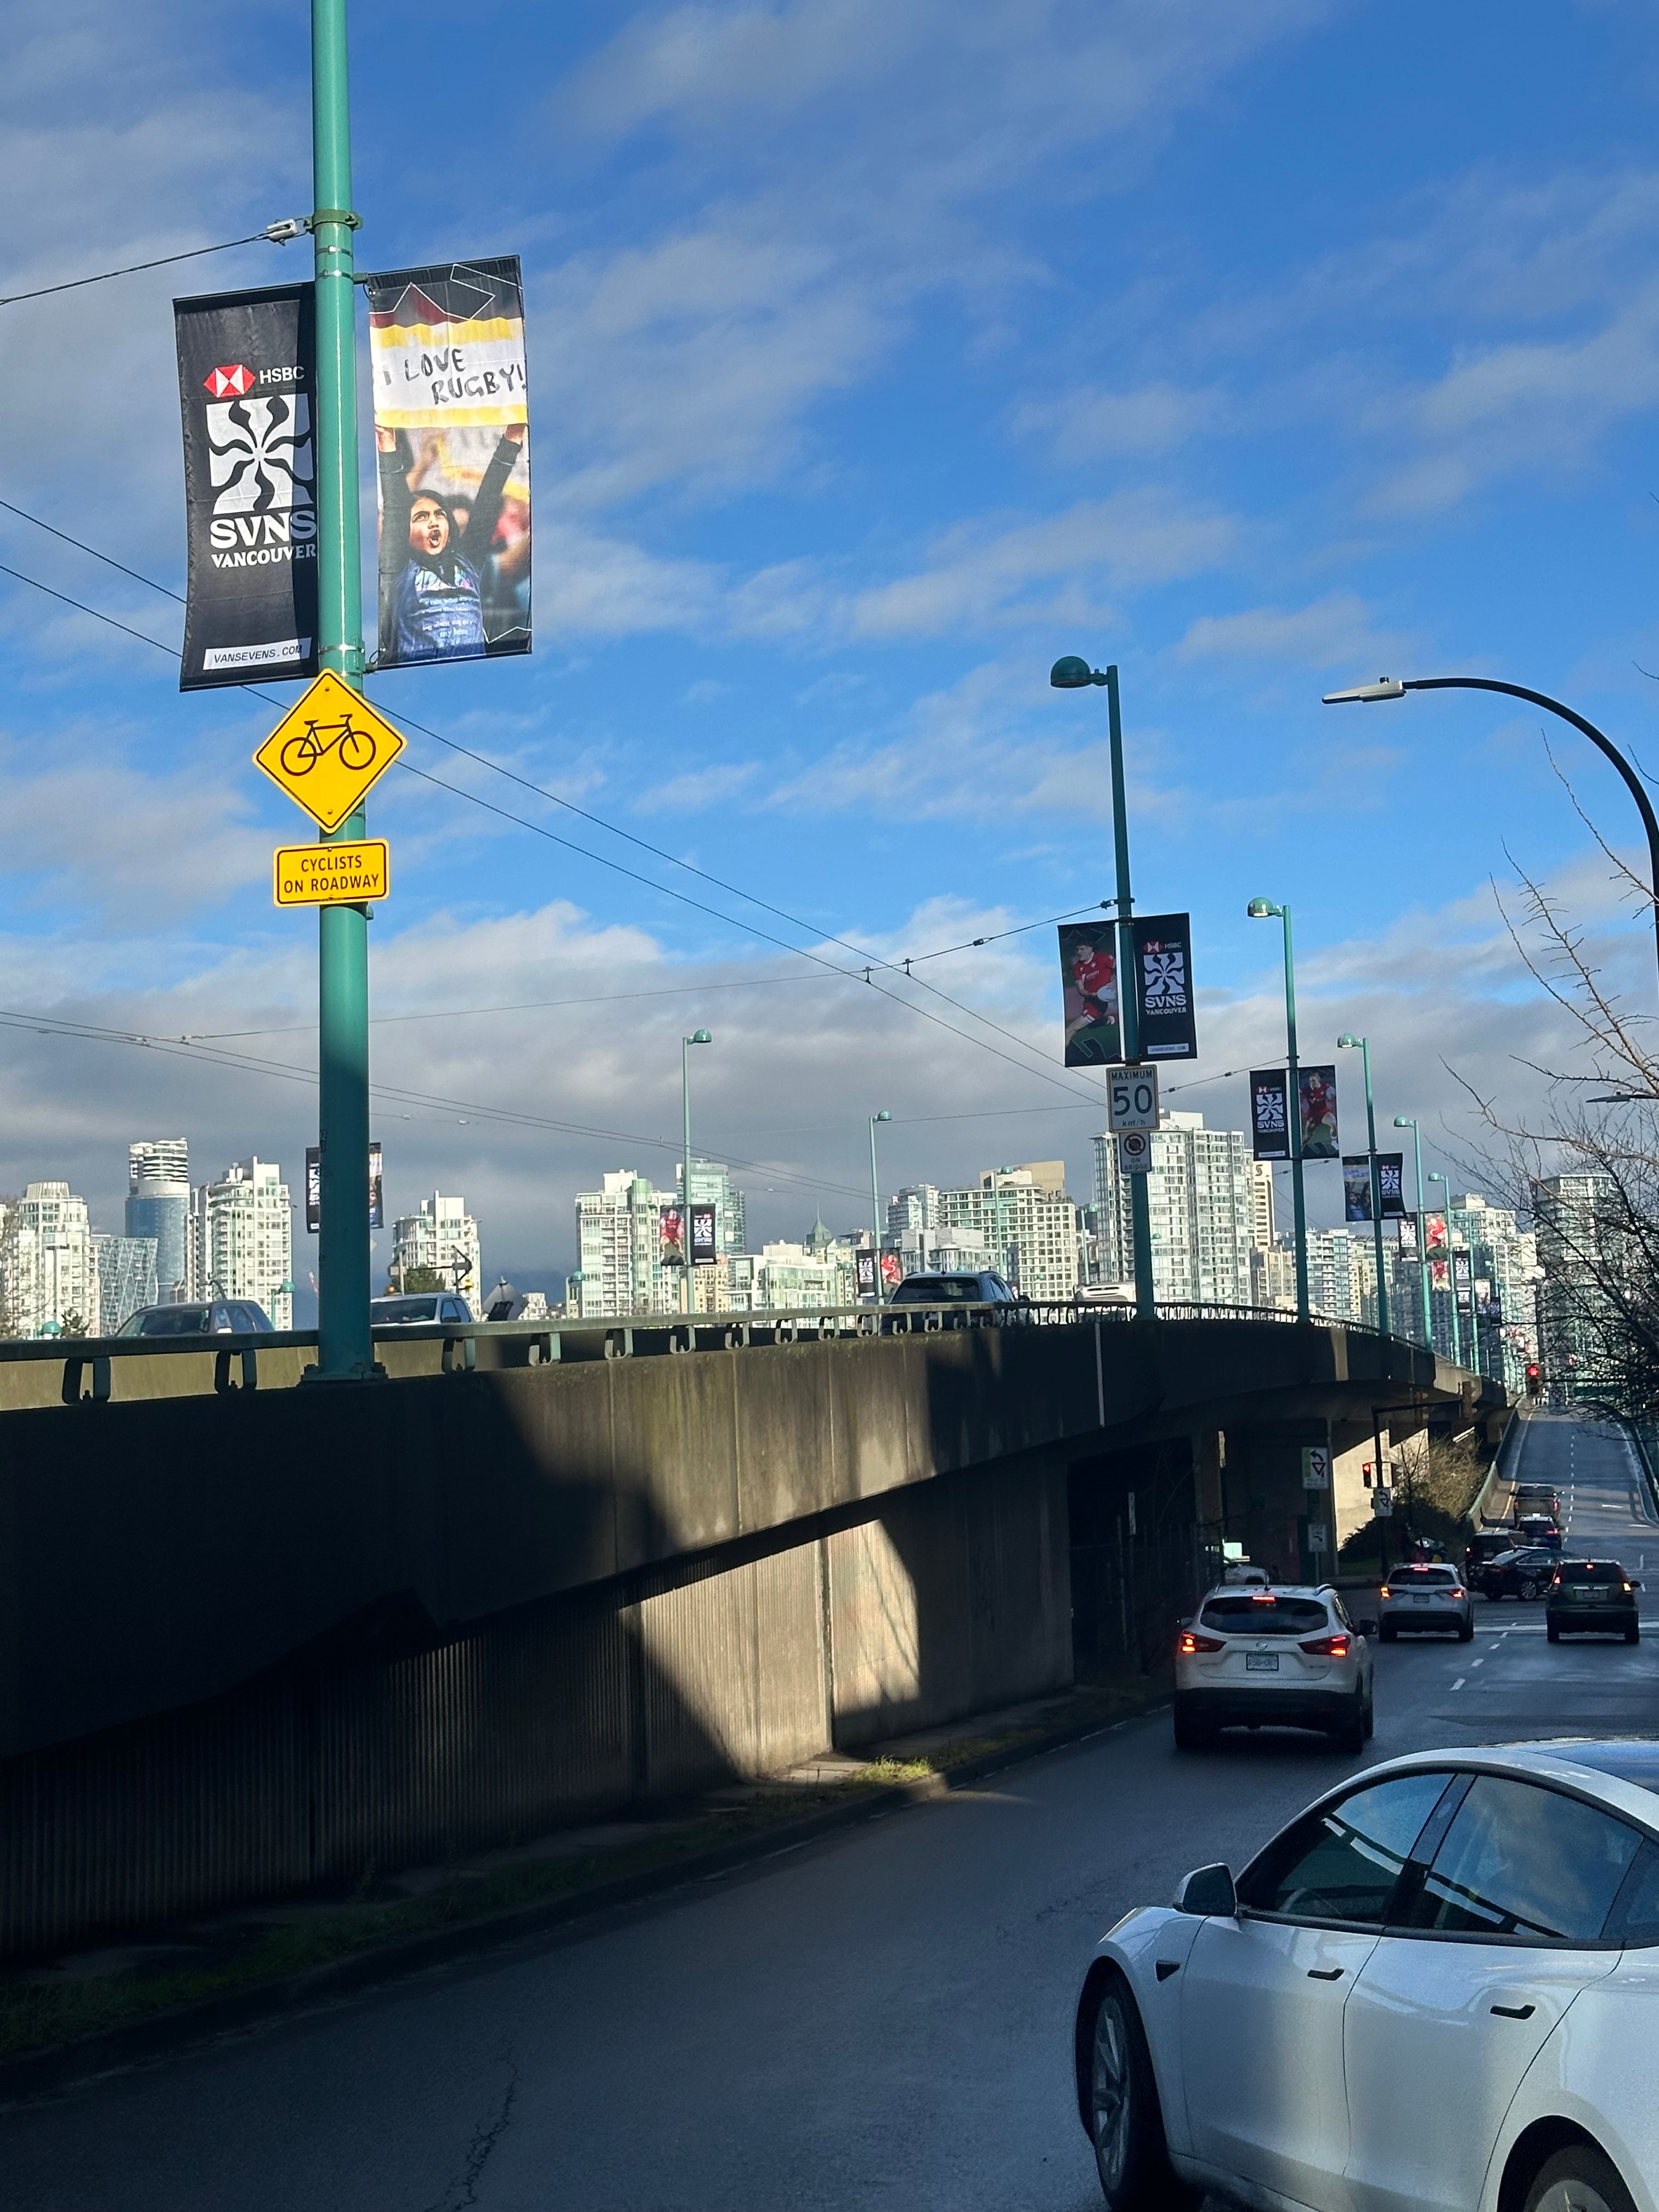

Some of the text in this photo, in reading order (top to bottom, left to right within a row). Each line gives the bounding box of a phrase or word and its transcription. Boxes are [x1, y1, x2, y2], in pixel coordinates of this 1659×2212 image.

[404, 347, 466, 382] LOVE
[259, 365, 305, 385] HSBC
[431, 363, 527, 405] RUGBY!
[210, 510, 317, 549] SVNS
[211, 543, 317, 568] VANCOUVER
[301, 855, 363, 872] CYCLISTS
[284, 873, 379, 894] ON ROADWAY
[1164, 941, 1182, 950] HSBC
[1144, 994, 1187, 1008] SVNS
[1146, 1006, 1187, 1015] VANCOUVER
[1111, 1070, 1153, 1081] MAXIMUM
[1113, 1084, 1153, 1116] 50
[1257, 1120, 1285, 1129] SVNS
[1124, 1163, 1148, 1171] BRIDGE
